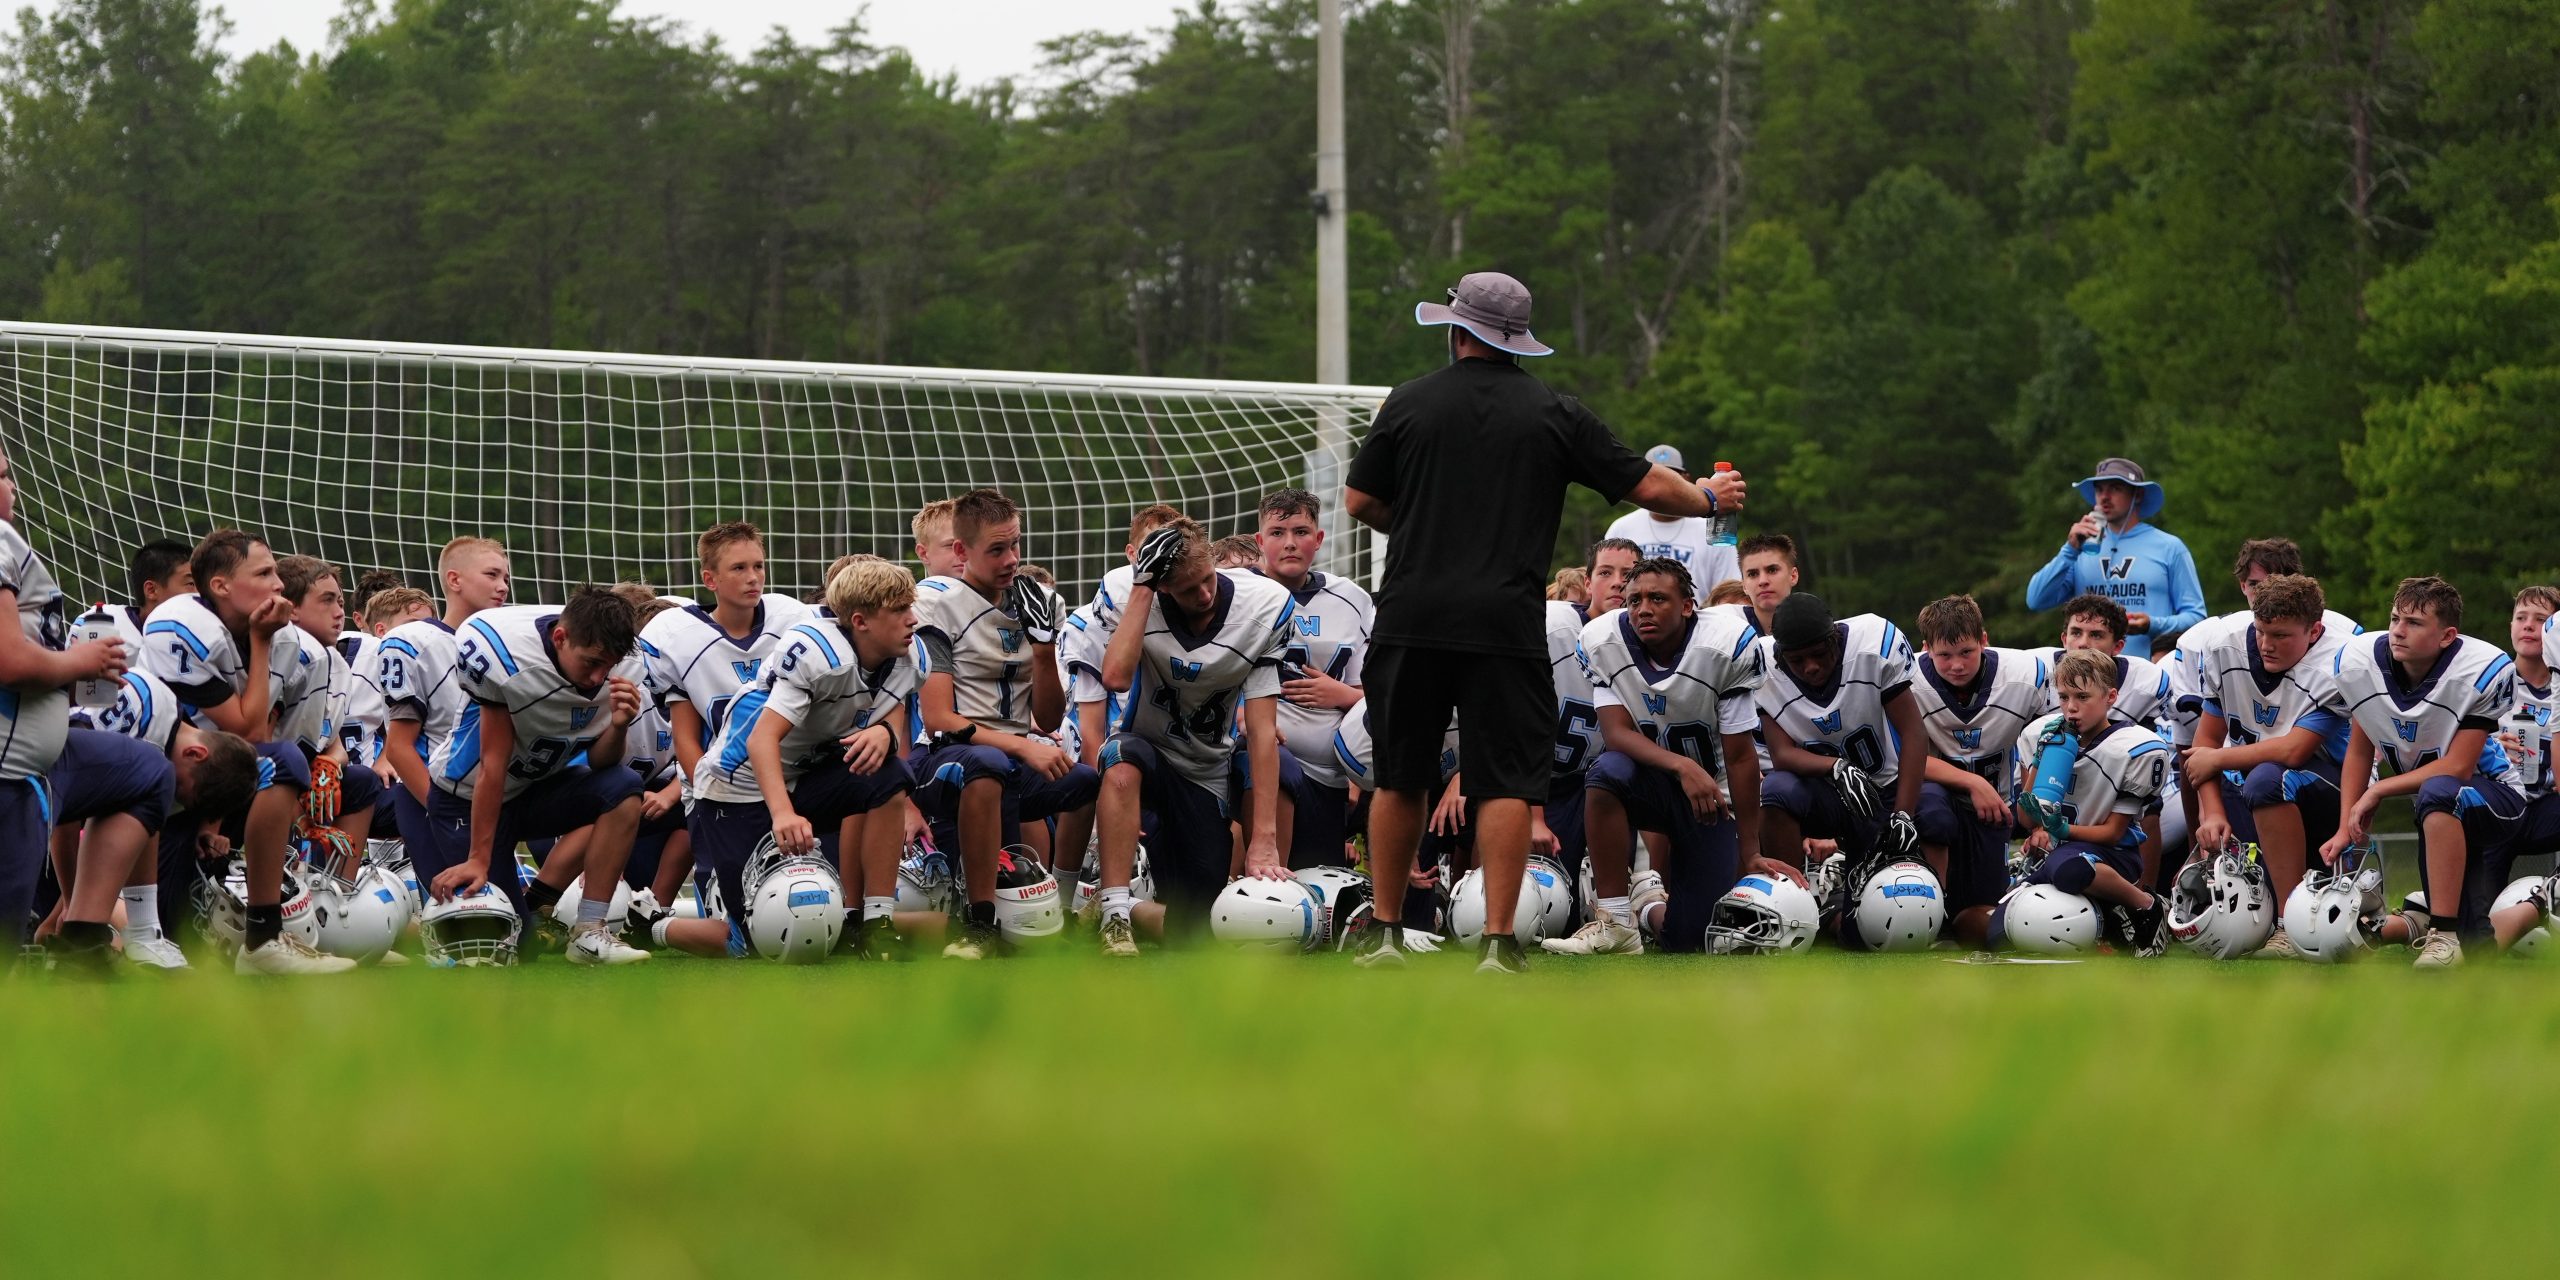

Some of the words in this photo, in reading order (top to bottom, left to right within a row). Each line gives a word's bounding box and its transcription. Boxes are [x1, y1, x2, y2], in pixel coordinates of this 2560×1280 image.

[2100, 557, 2134, 579] W
[1294, 615, 1320, 636] W
[997, 627, 1025, 653] W
[169, 641, 193, 675] 7
[782, 641, 807, 672] 5
[1170, 656, 1203, 682] W
[380, 656, 405, 690] 23
[731, 658, 761, 684] W
[1641, 692, 1667, 716] W
[2253, 699, 2281, 728] W
[570, 706, 599, 731] W
[1811, 709, 1843, 735] W
[1803, 723, 1886, 777] 0
[1953, 728, 1982, 750] W
[2151, 756, 2165, 789] 8
[1019, 880, 1057, 899] Riddell
[2173, 923, 2199, 939] Ridd
